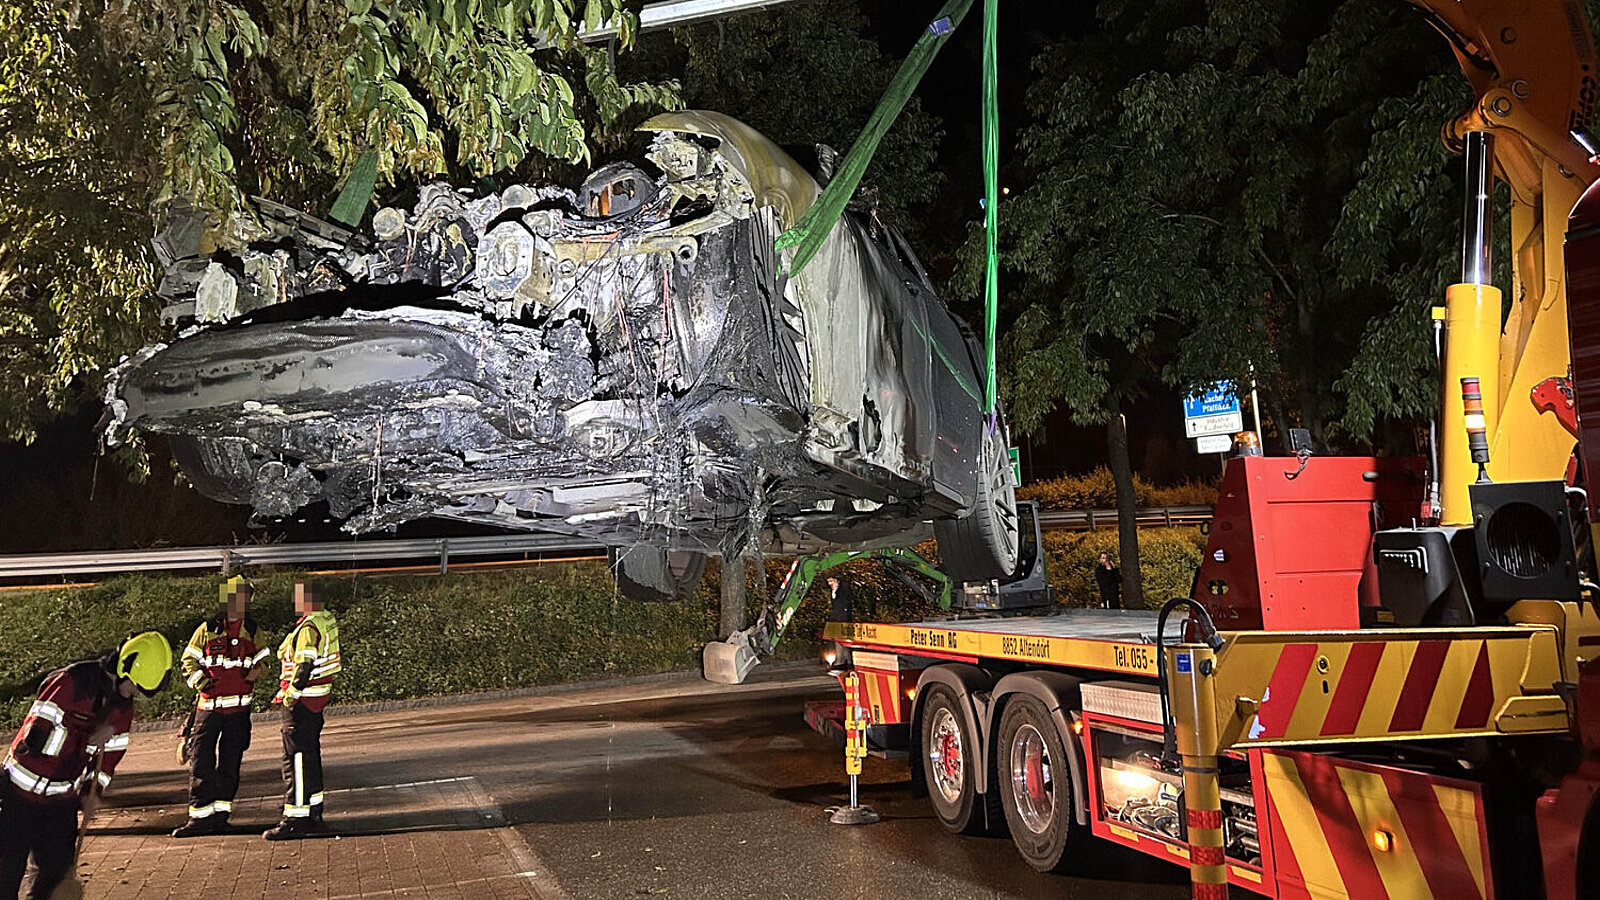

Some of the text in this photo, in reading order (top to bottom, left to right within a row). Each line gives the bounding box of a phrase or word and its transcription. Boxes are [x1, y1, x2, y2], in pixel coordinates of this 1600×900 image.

[910, 629, 928, 645] Peter
[929, 630, 945, 648] Senn
[1002, 637, 1050, 659] 8852 Altendorf
